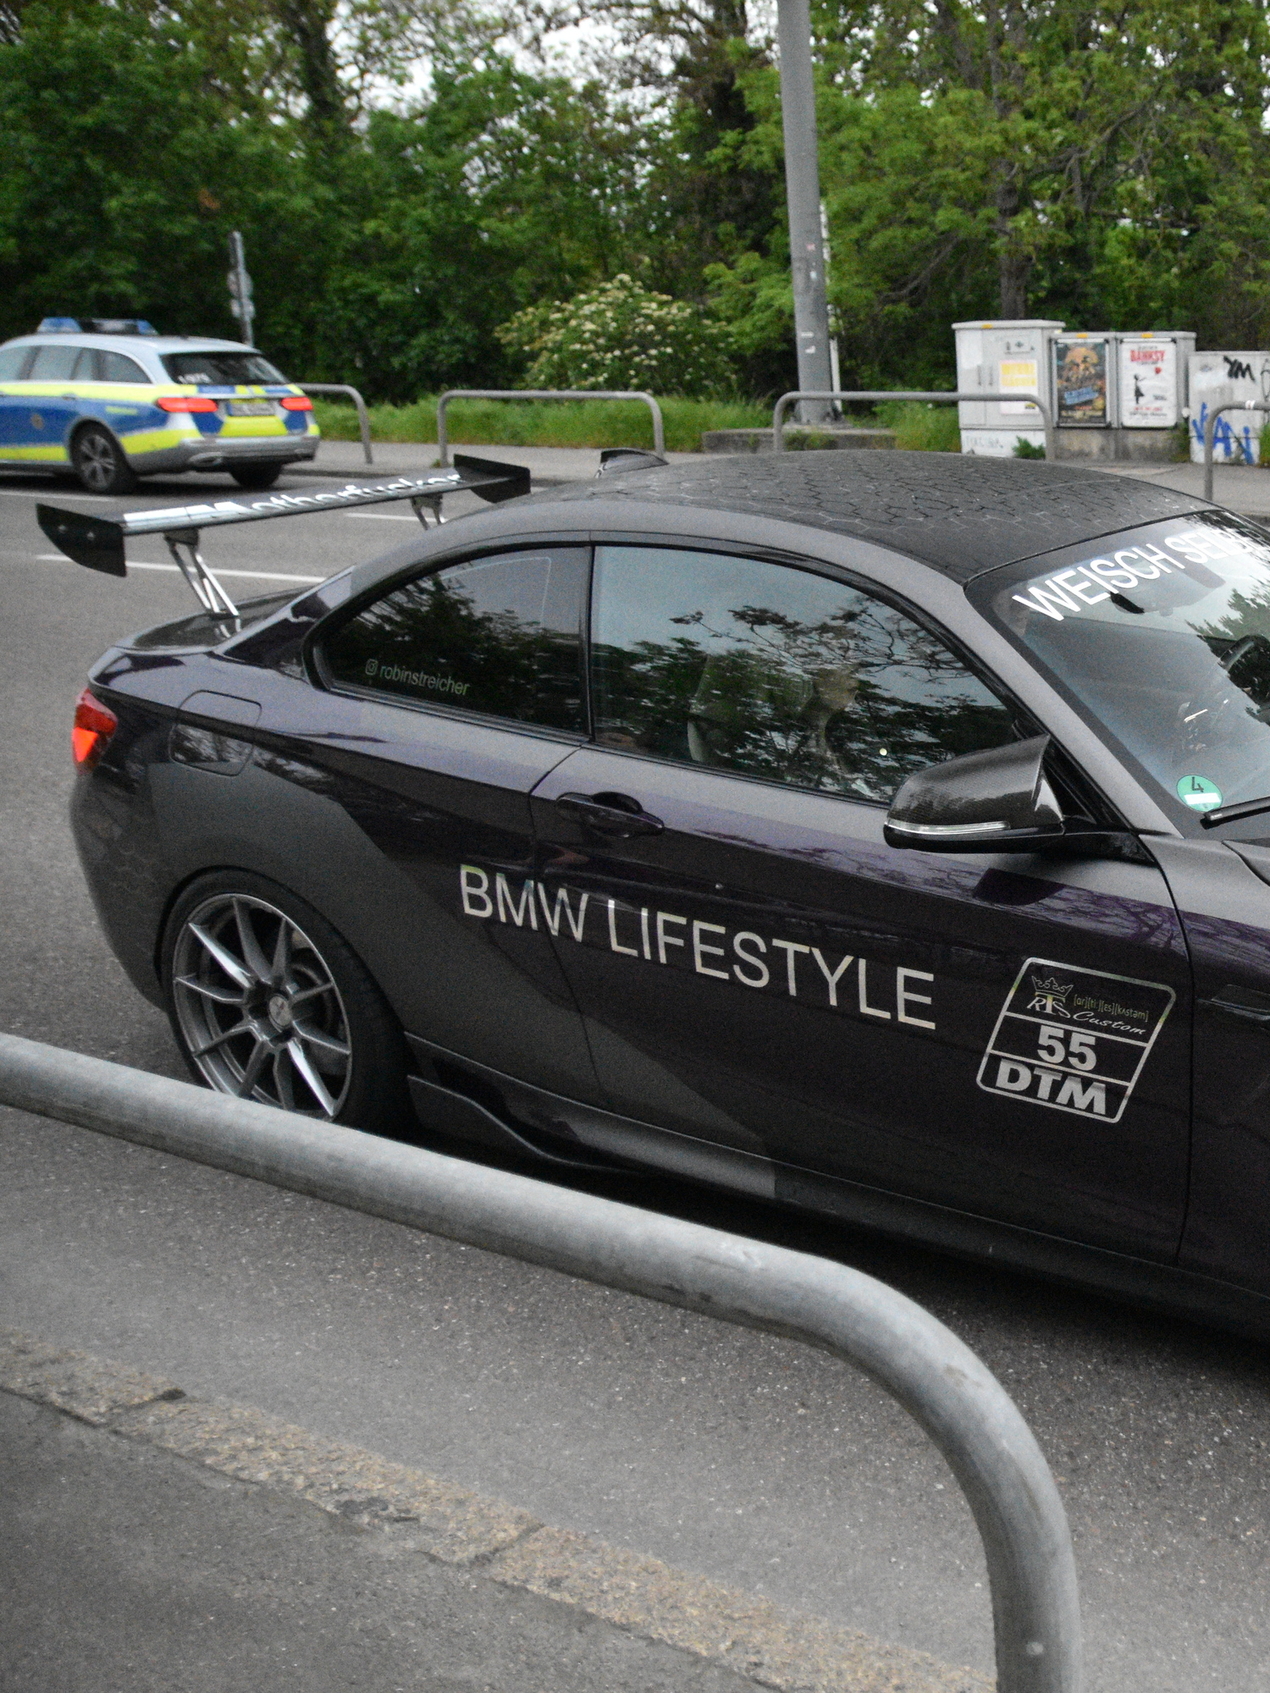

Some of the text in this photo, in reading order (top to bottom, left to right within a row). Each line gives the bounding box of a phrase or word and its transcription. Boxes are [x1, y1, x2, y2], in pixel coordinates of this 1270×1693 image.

[1011, 542, 1186, 622] WEISCH
[380, 664, 471, 696] robinstreicher
[1191, 776, 1204, 793] 4
[459, 863, 937, 1031] BMW LIFESTYLE
[1072, 1010, 1147, 1036] Custom
[1036, 1024, 1098, 1072] 55
[994, 1057, 1107, 1115] DTM
